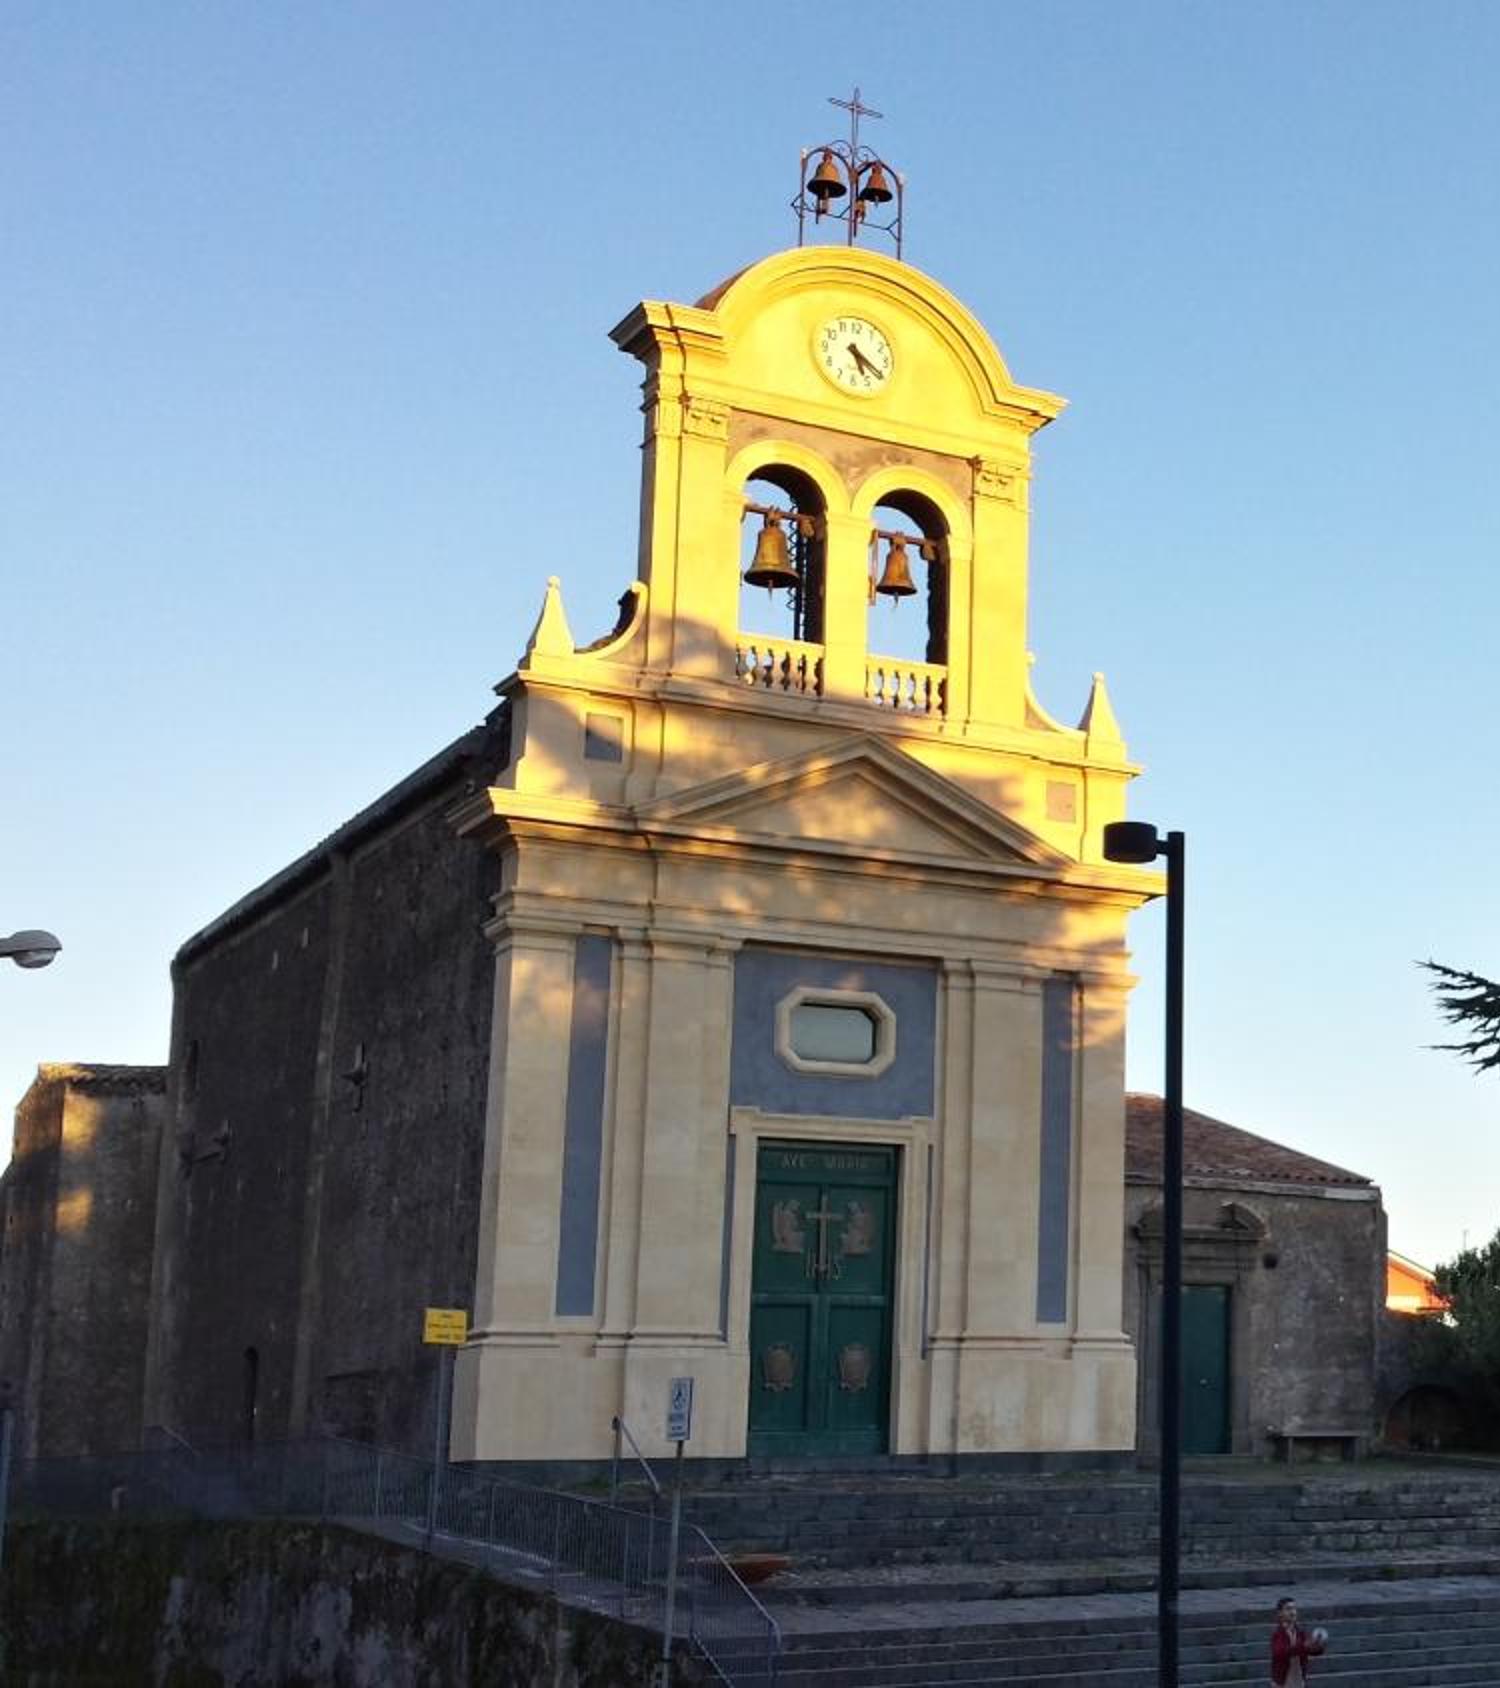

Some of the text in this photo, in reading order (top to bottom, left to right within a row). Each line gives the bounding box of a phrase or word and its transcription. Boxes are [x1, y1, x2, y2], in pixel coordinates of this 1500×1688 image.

[839, 321, 847, 333] 11
[851, 322, 863, 334] 12
[824, 327, 837, 340] 10
[821, 340, 829, 352] 9
[877, 341, 884, 353] 2
[826, 355, 832, 367] 8
[882, 356, 889, 368] 3
[837, 368, 843, 379] 7
[850, 374, 857, 386] 6
[864, 375, 871, 387] 5
